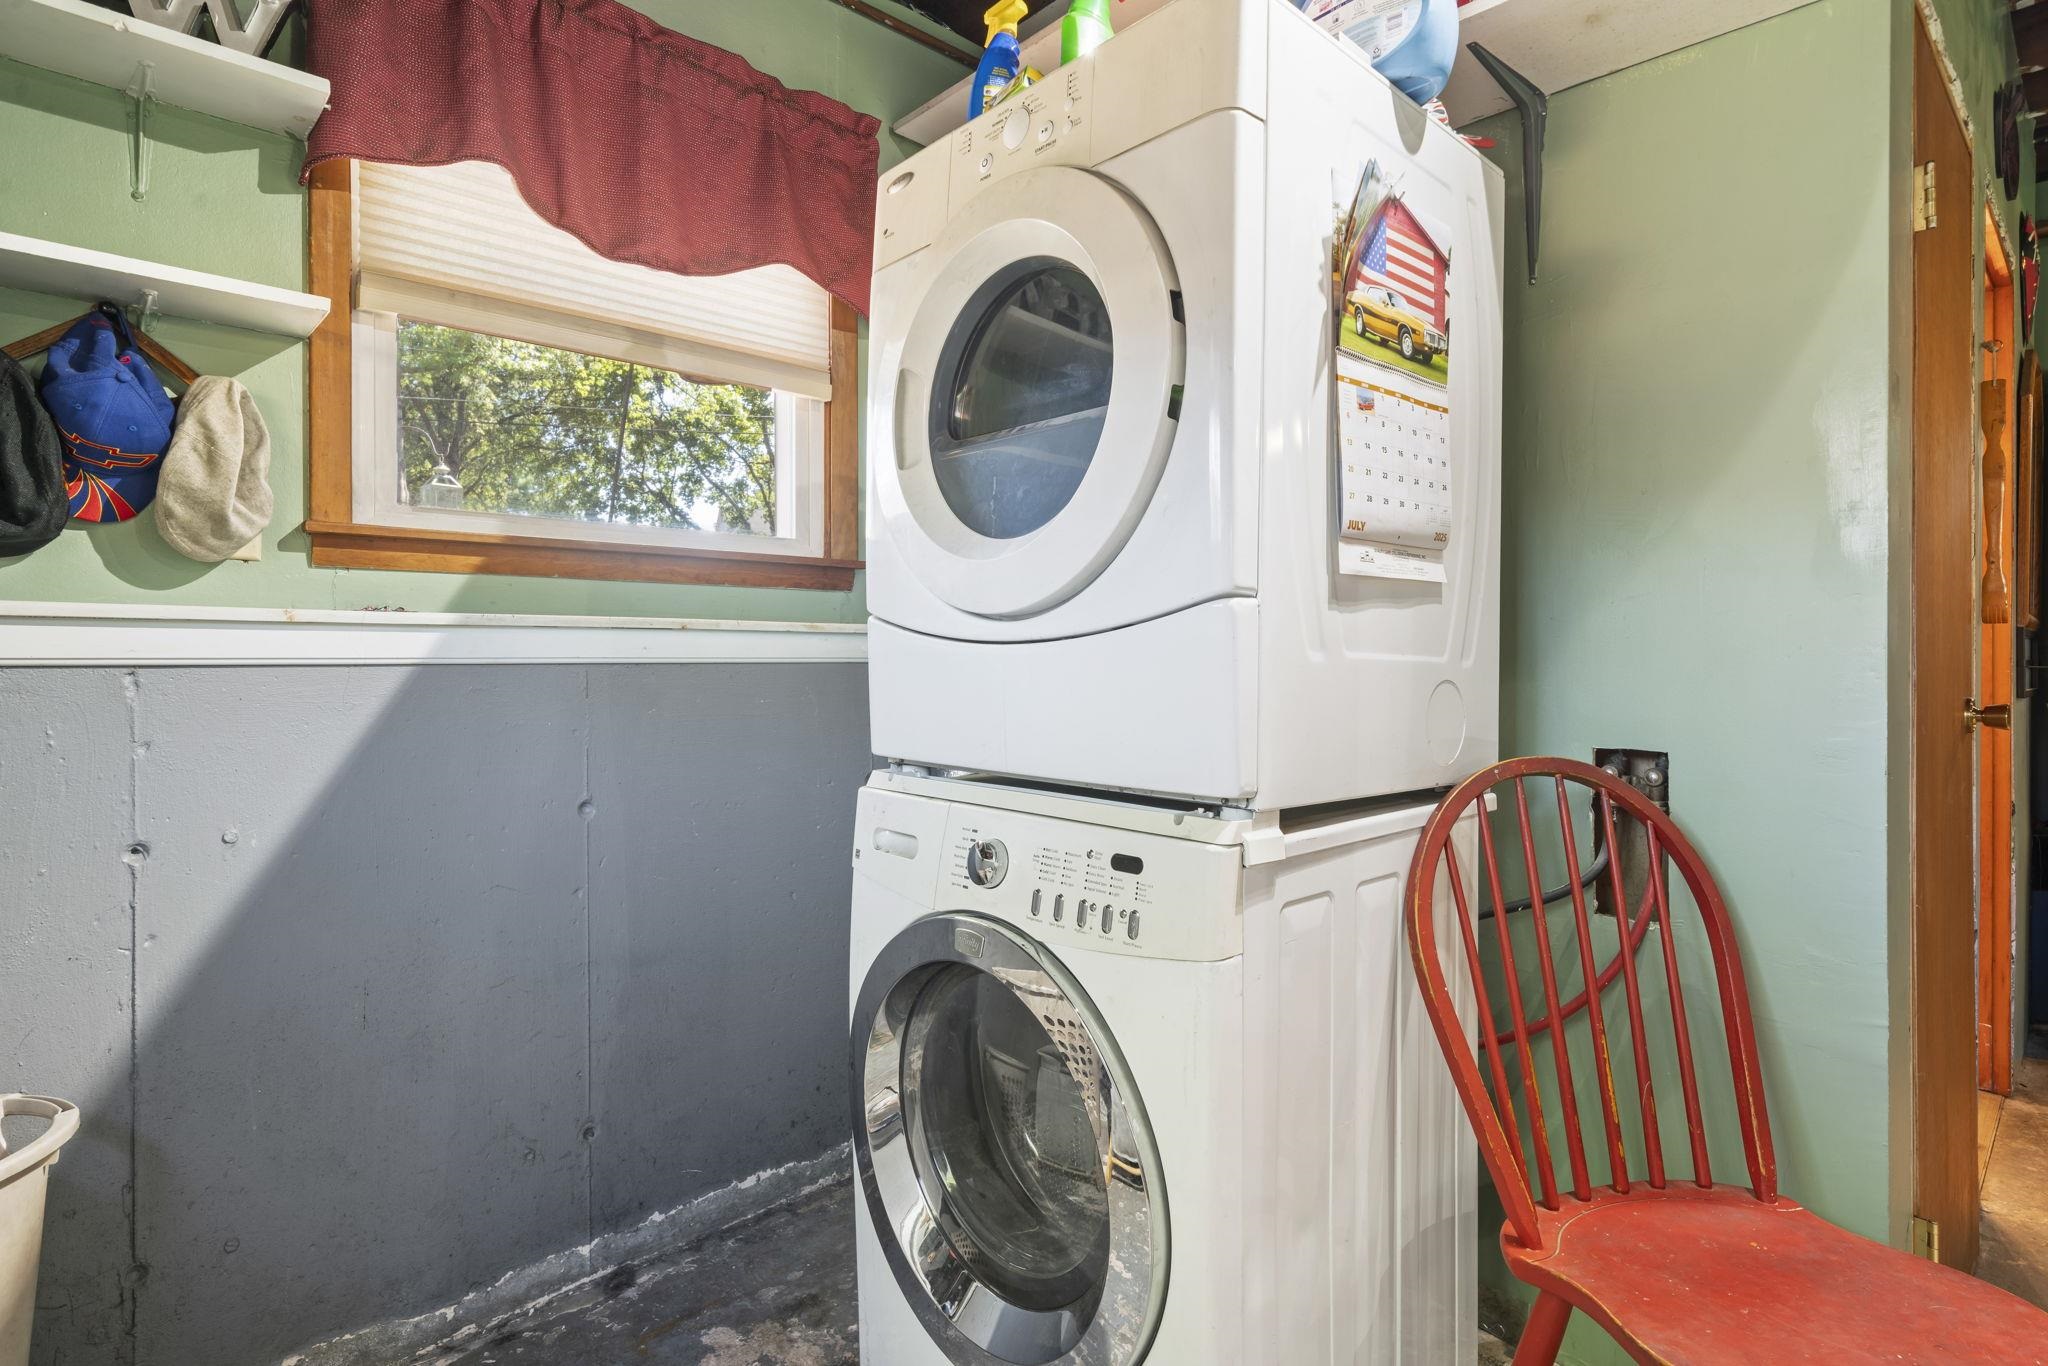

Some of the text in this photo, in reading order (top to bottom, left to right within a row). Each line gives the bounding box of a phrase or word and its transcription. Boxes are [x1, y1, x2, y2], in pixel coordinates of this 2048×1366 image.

[1366, 468, 1371, 476] 21
[1367, 495, 1372, 503] 28
[1347, 520, 1447, 542] JULY 2025
